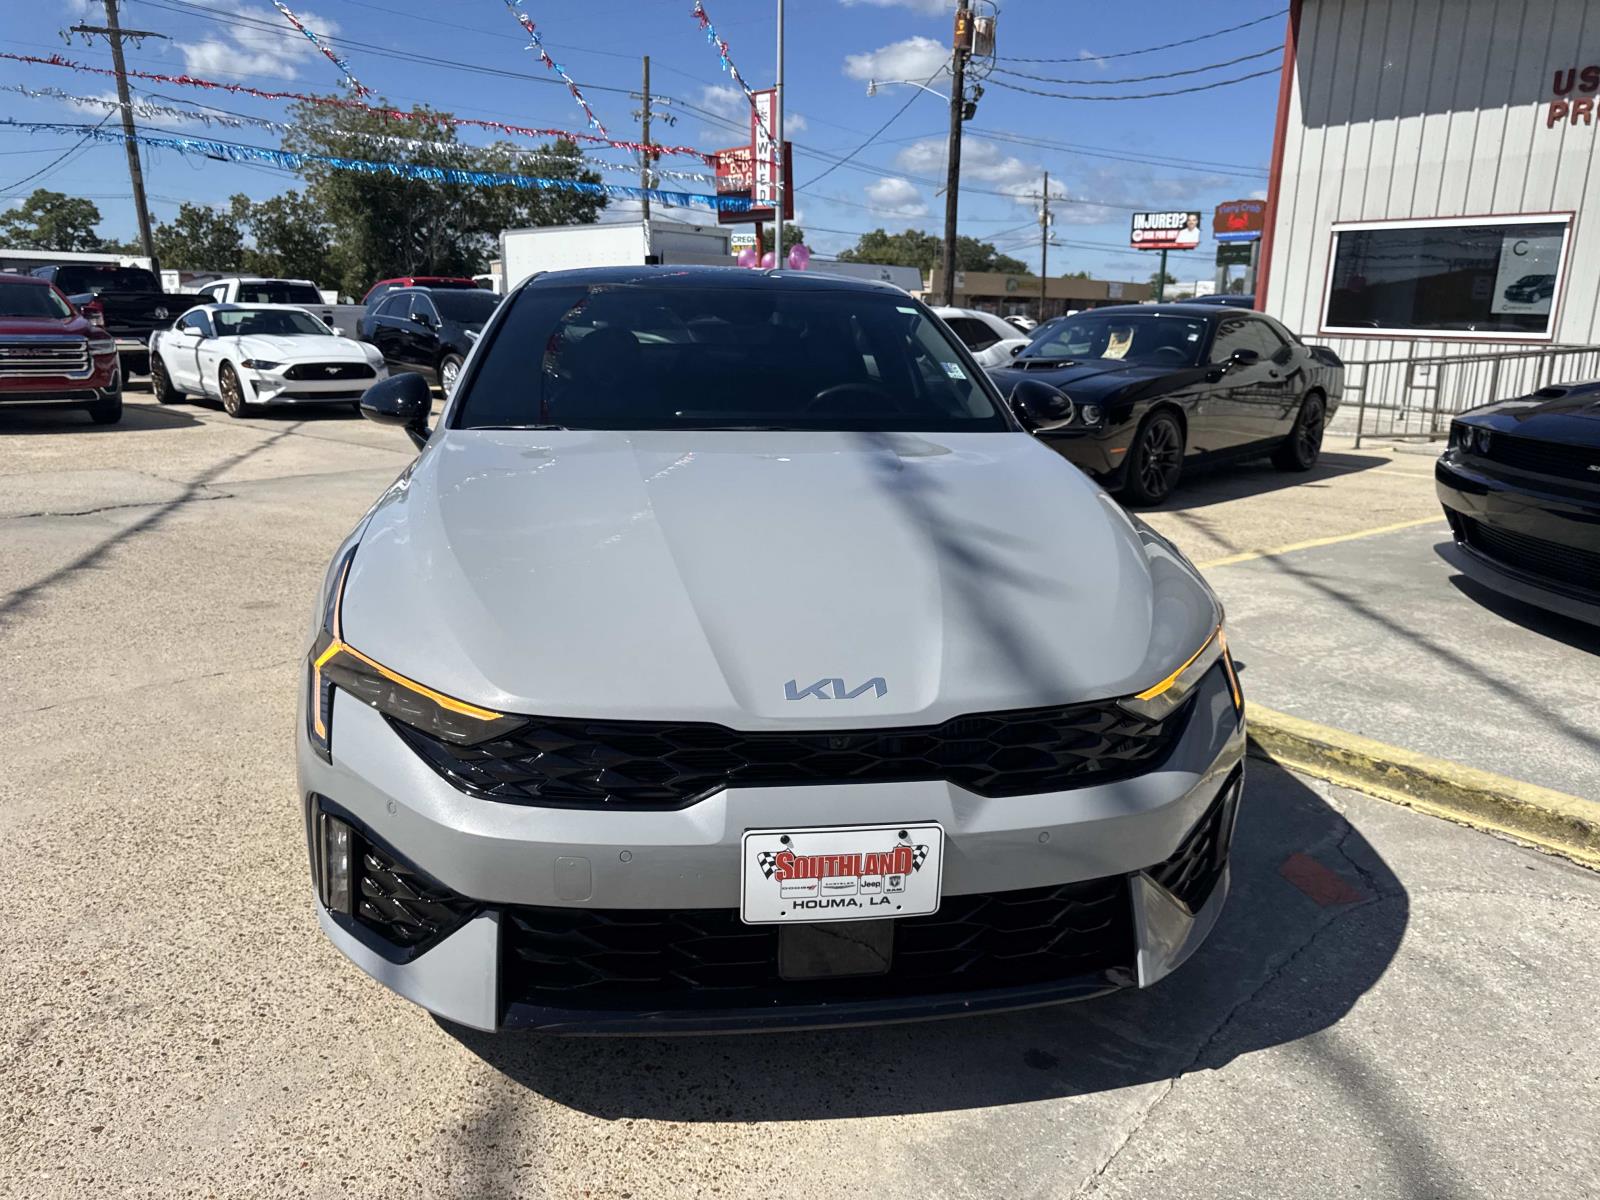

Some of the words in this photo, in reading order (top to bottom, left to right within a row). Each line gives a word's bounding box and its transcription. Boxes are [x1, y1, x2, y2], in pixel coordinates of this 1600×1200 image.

[1547, 96, 1600, 129] PR
[1133, 213, 1187, 229] INJURED?
[784, 677, 888, 701] KIA
[774, 846, 913, 882] SOUTHLAND
[861, 880, 881, 889] Jeep
[792, 897, 863, 910] HOUMA,
[869, 896, 892, 906] LA
